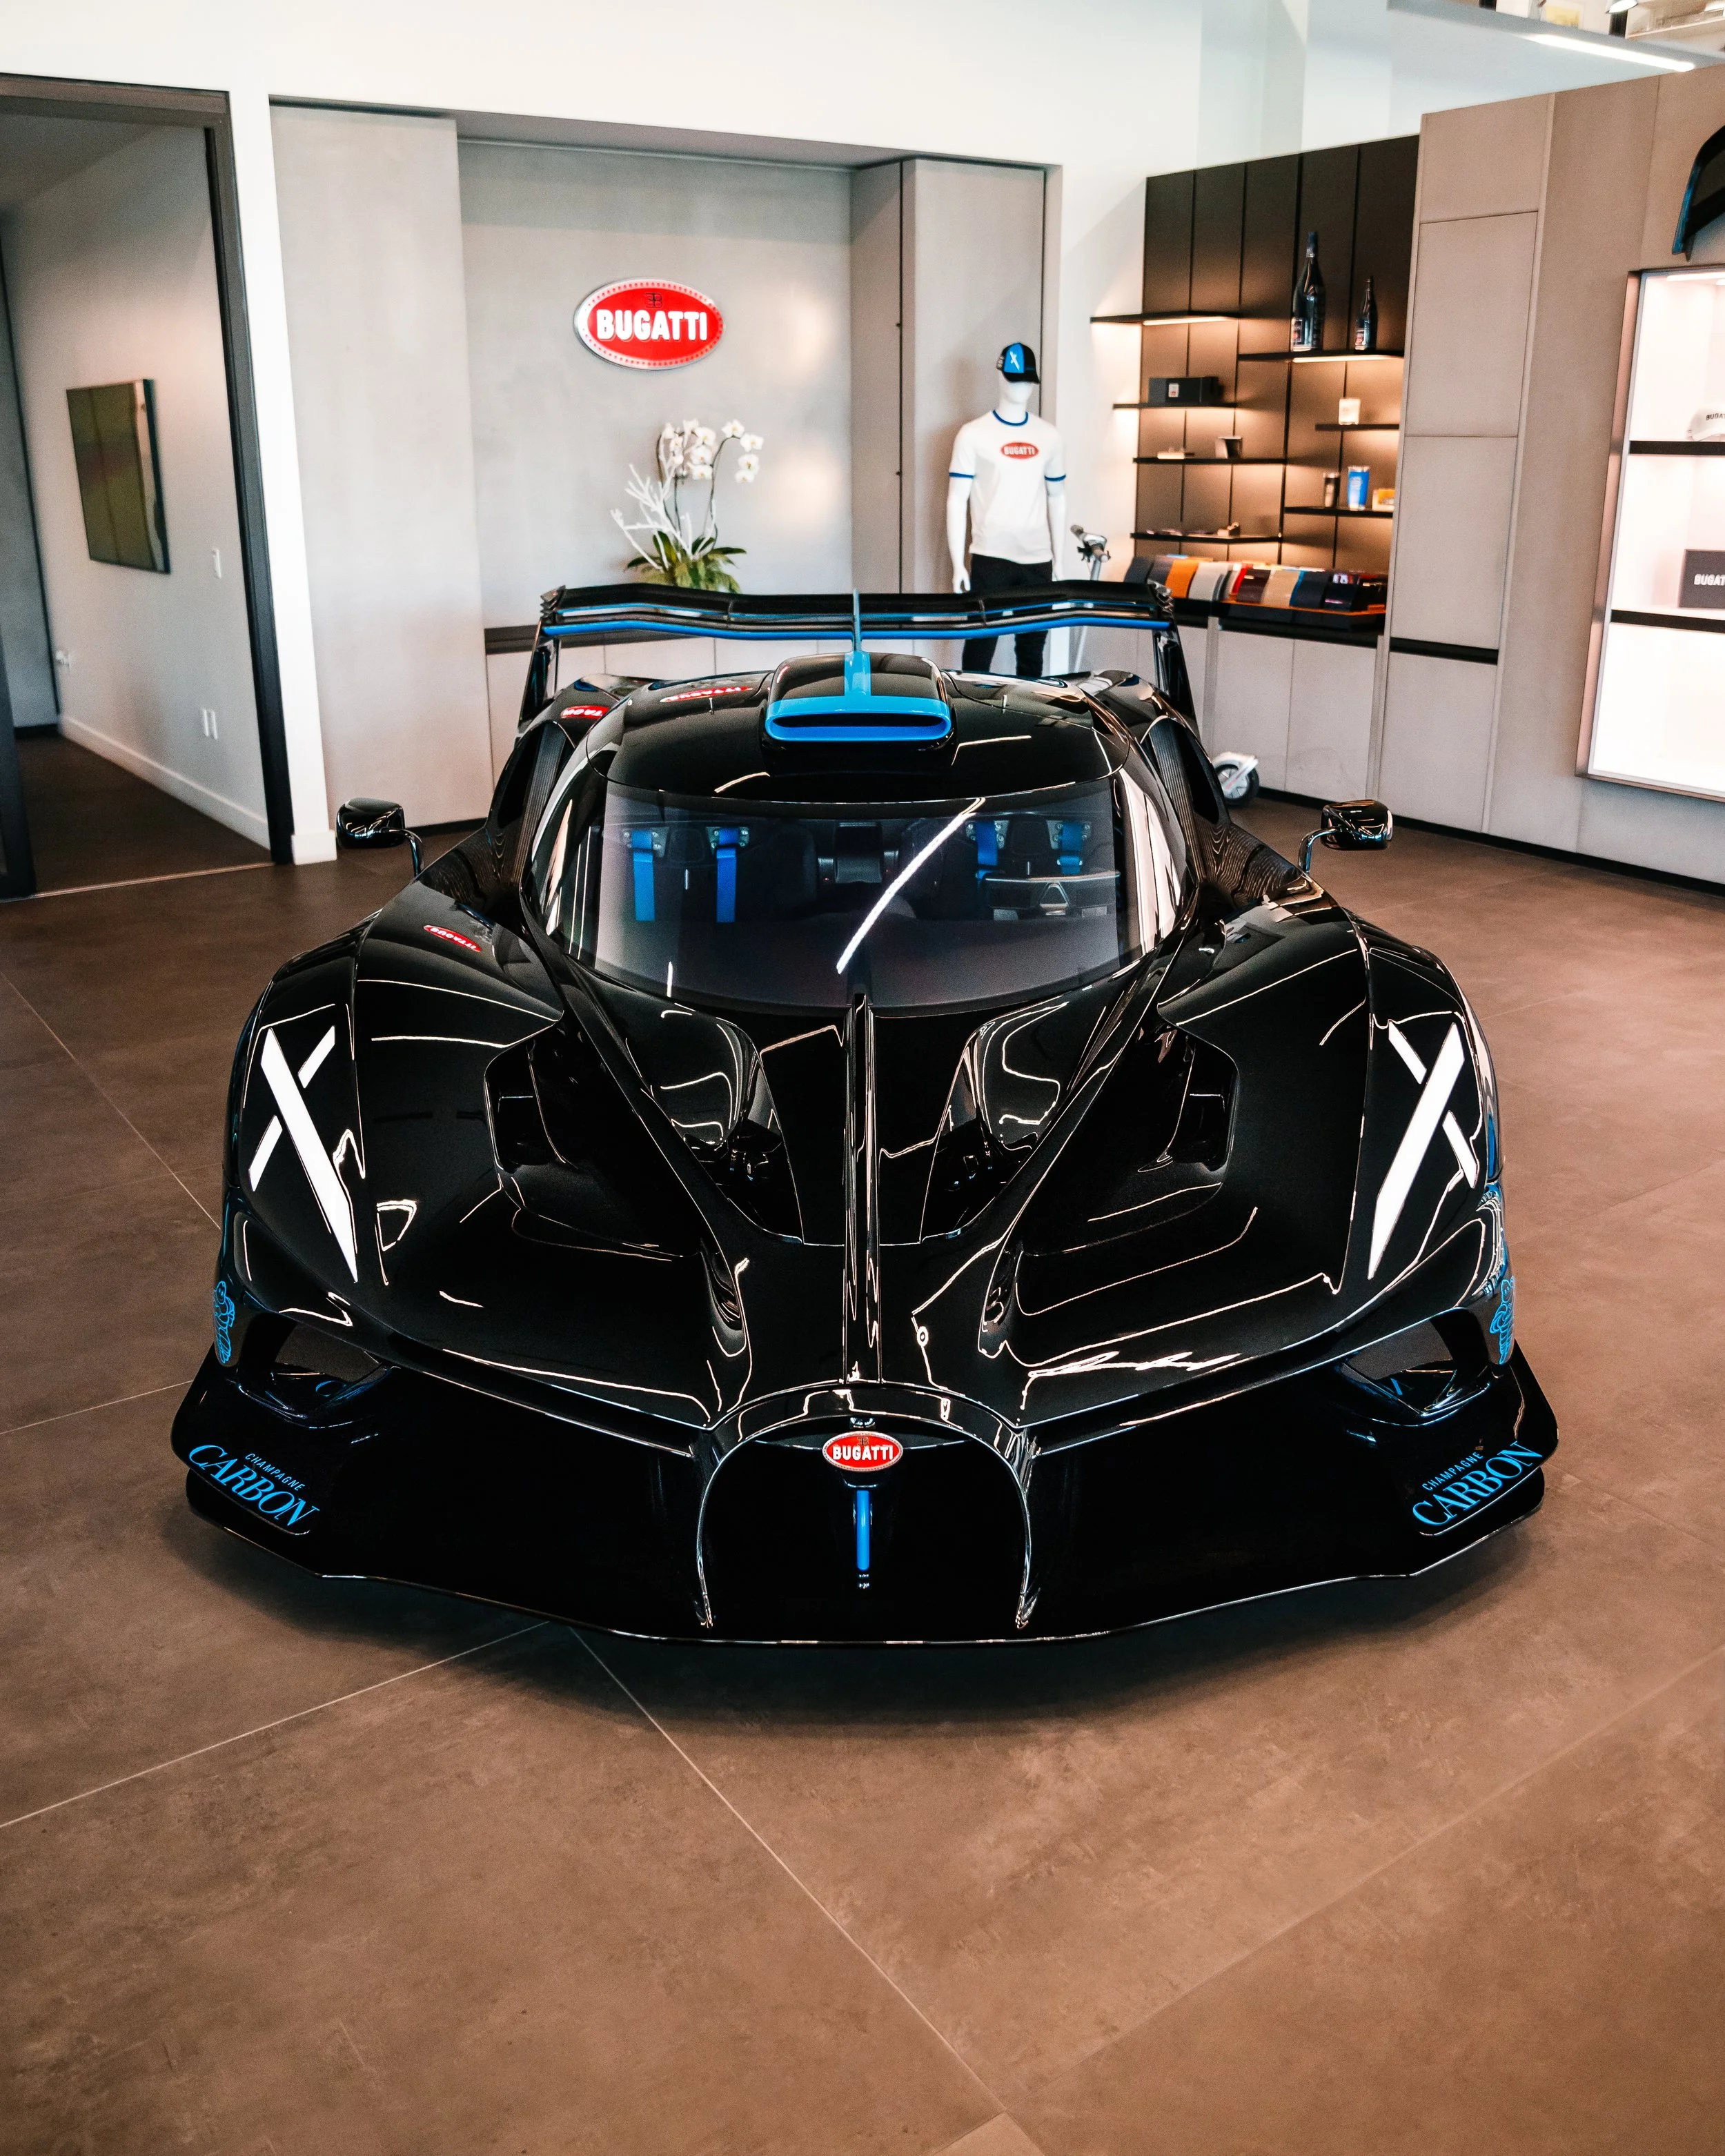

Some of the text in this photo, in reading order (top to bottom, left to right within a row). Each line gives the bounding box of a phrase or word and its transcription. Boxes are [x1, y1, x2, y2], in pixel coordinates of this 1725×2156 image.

[596, 309, 707, 341] BUGATTI
[1706, 413, 1725, 421] BUGA
[1003, 446, 1035, 455] BUGATTI
[832, 1445, 894, 1461] BUGATTI
[188, 1445, 320, 1526] CARBON
[245, 1453, 305, 1491] CHAMPAGNE
[1412, 1441, 1543, 1525] CARBON
[1421, 1452, 1483, 1491] CHAMPAGNE
